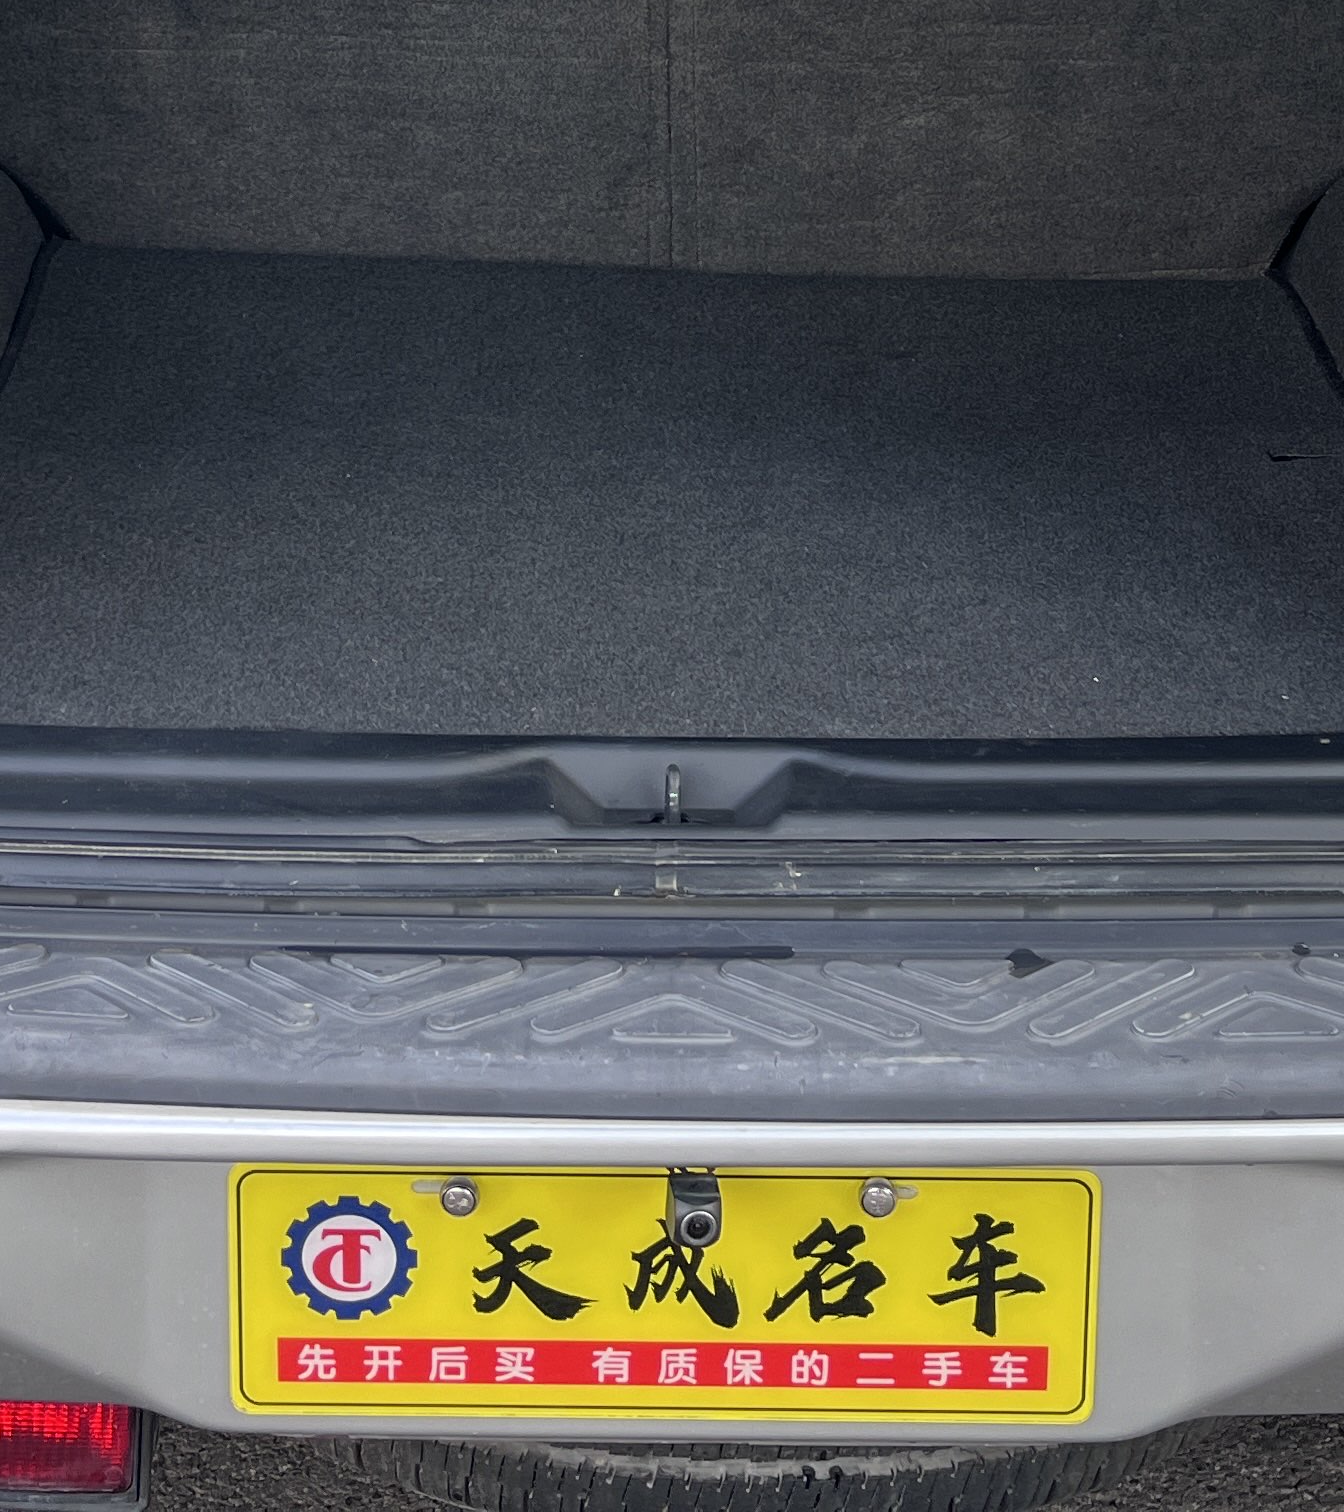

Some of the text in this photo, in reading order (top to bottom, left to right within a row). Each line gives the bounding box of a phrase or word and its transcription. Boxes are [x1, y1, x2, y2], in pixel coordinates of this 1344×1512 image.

[472, 1213, 1046, 1337] 天成名车
[297, 1343, 1029, 1389] 先开后买 有质保的二手车
